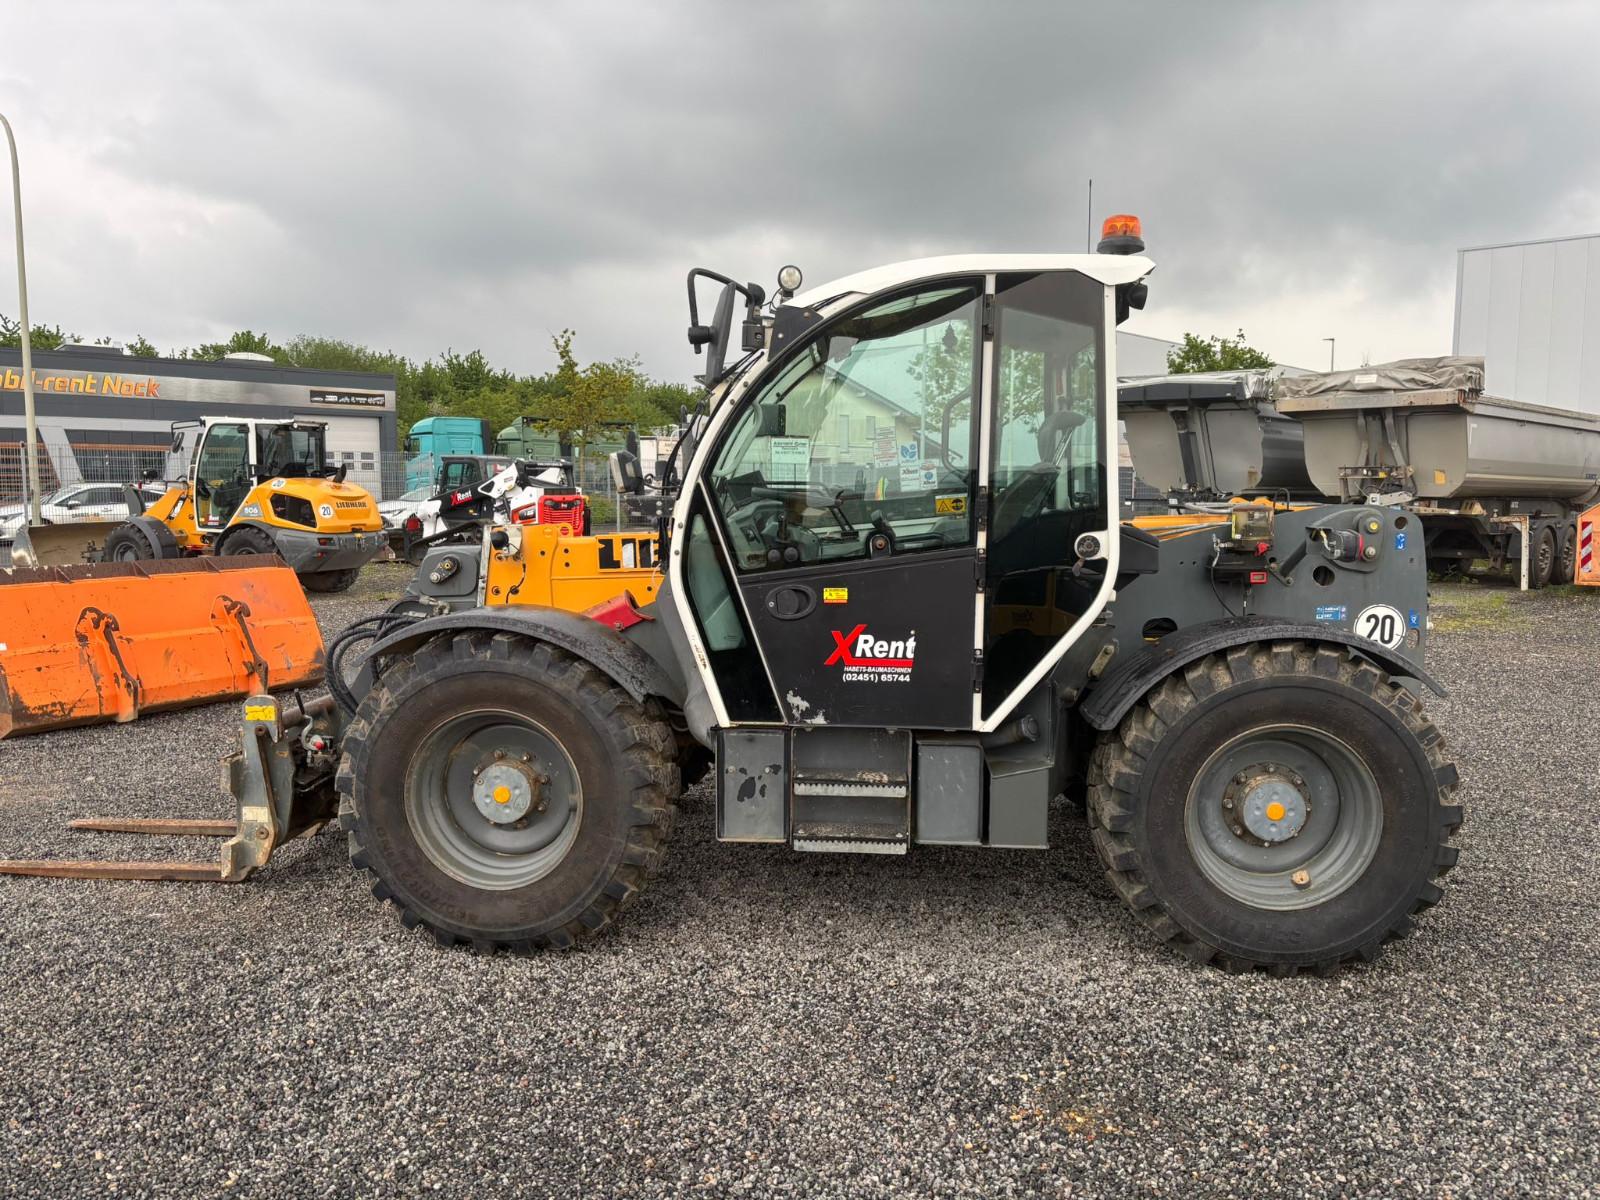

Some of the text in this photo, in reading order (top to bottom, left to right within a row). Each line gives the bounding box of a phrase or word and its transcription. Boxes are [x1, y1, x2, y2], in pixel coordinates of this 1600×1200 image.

[0, 369, 161, 398] b-rent Nock
[321, 506, 332, 516] 20
[1366, 613, 1395, 645] 20
[824, 624, 916, 665] XRent
[842, 673, 911, 683] (02451) 65744
[843, 665, 912, 674] HABETS-BAUMASCHINEN
